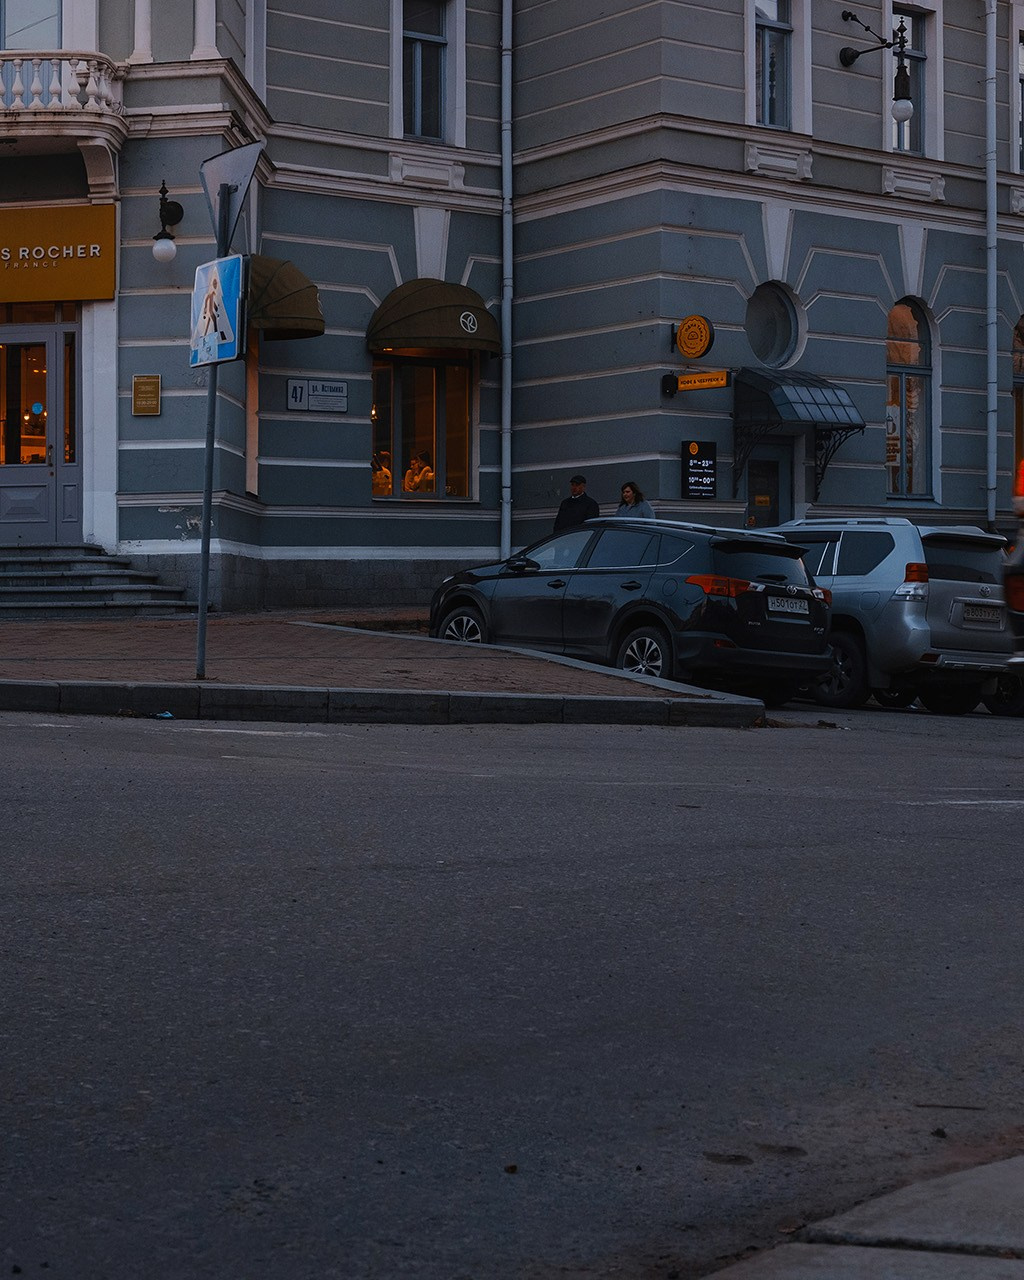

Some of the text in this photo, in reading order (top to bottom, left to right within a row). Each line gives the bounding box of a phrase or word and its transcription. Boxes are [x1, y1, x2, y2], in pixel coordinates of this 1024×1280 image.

[18, 244, 102, 261] ROCHER
[4, 260, 58, 269] FRANCE
[291, 386, 304, 403] 47
